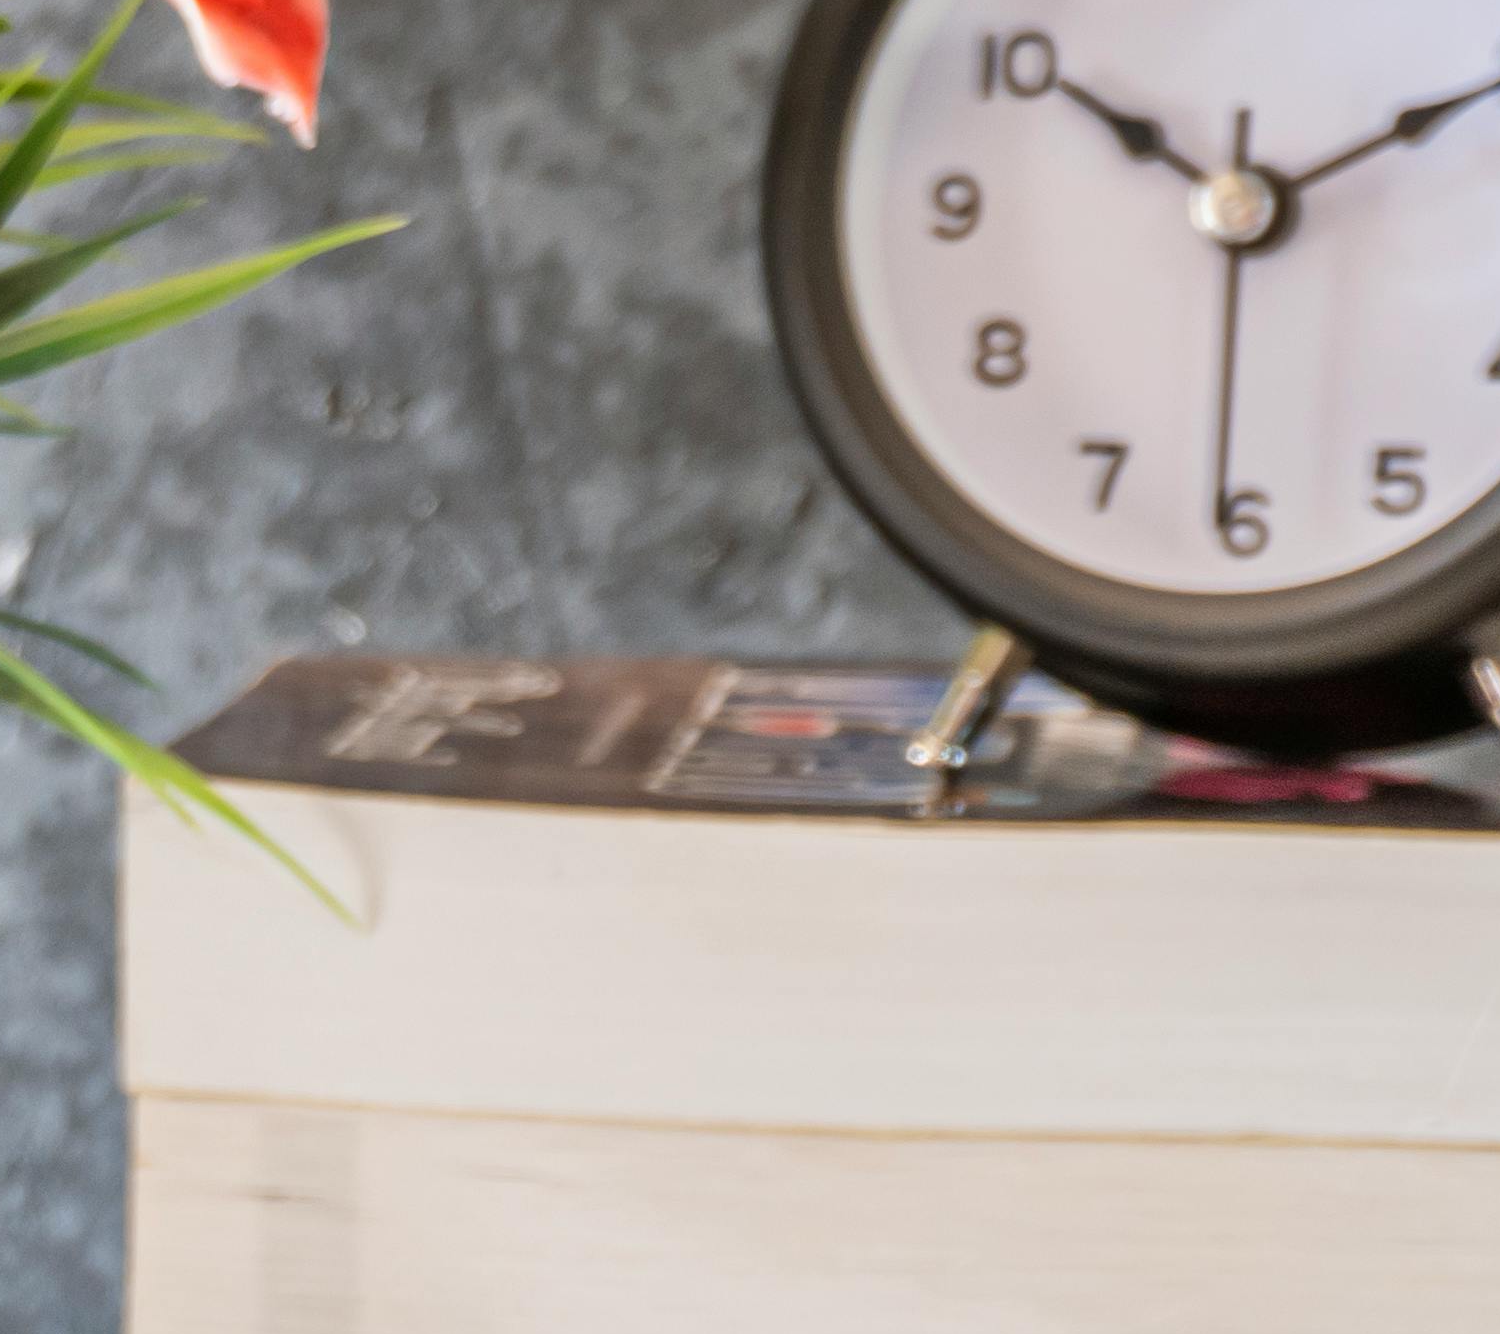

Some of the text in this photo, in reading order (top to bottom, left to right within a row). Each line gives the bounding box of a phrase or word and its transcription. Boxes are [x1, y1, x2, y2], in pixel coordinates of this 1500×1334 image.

[976, 28, 1055, 101] 10
[931, 173, 983, 243] 9
[972, 317, 1027, 389] 8
[1079, 440, 1130, 512] 7
[1373, 446, 1424, 516] 5
[1221, 487, 1270, 559] 6
